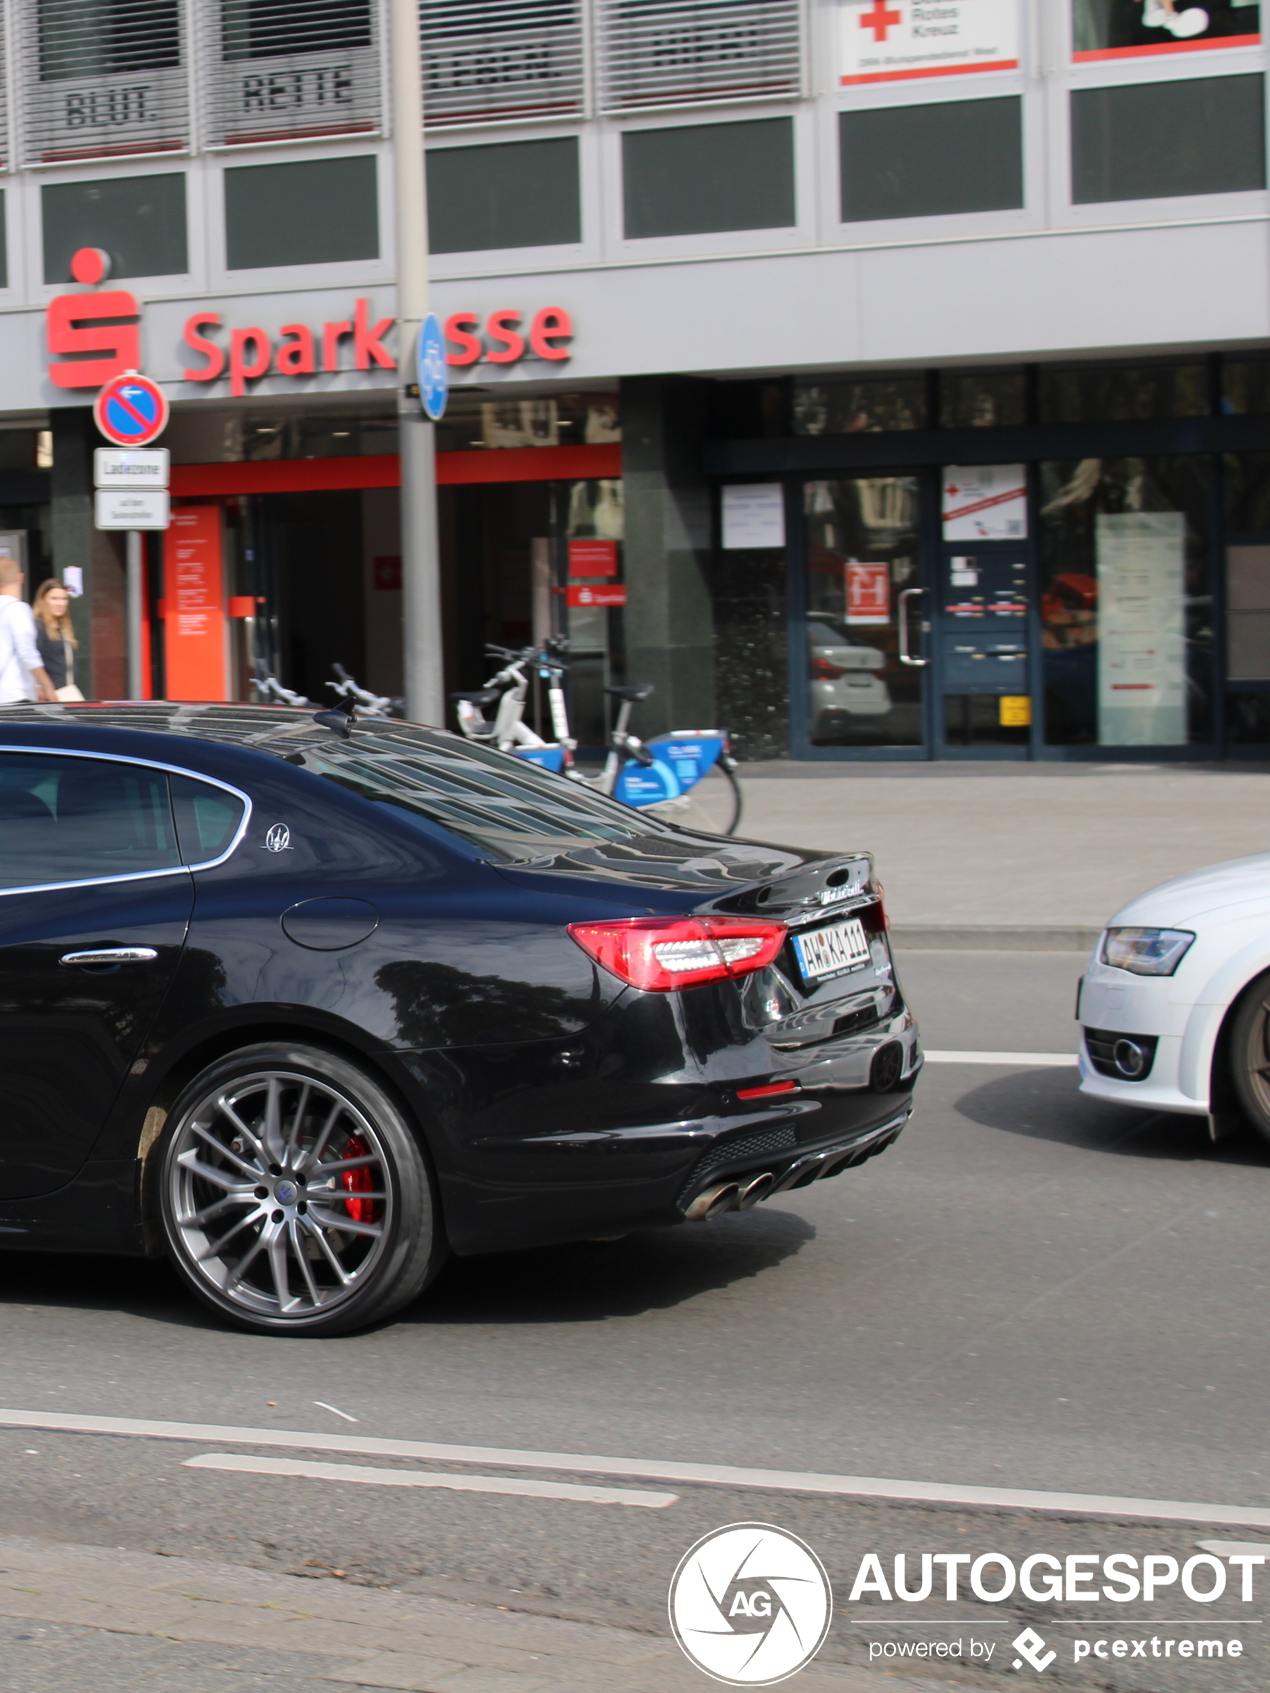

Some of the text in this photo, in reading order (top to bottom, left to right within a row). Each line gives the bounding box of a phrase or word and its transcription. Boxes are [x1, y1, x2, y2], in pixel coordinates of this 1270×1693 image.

[912, 8, 960, 20] Rotes
[912, 24, 960, 37] Kreuz
[243, 65, 352, 113] RETTE
[183, 298, 572, 397] Sparksse
[104, 460, 160, 475] Ladezone
[825, 930, 848, 965] KA
[844, 923, 868, 959] 111
